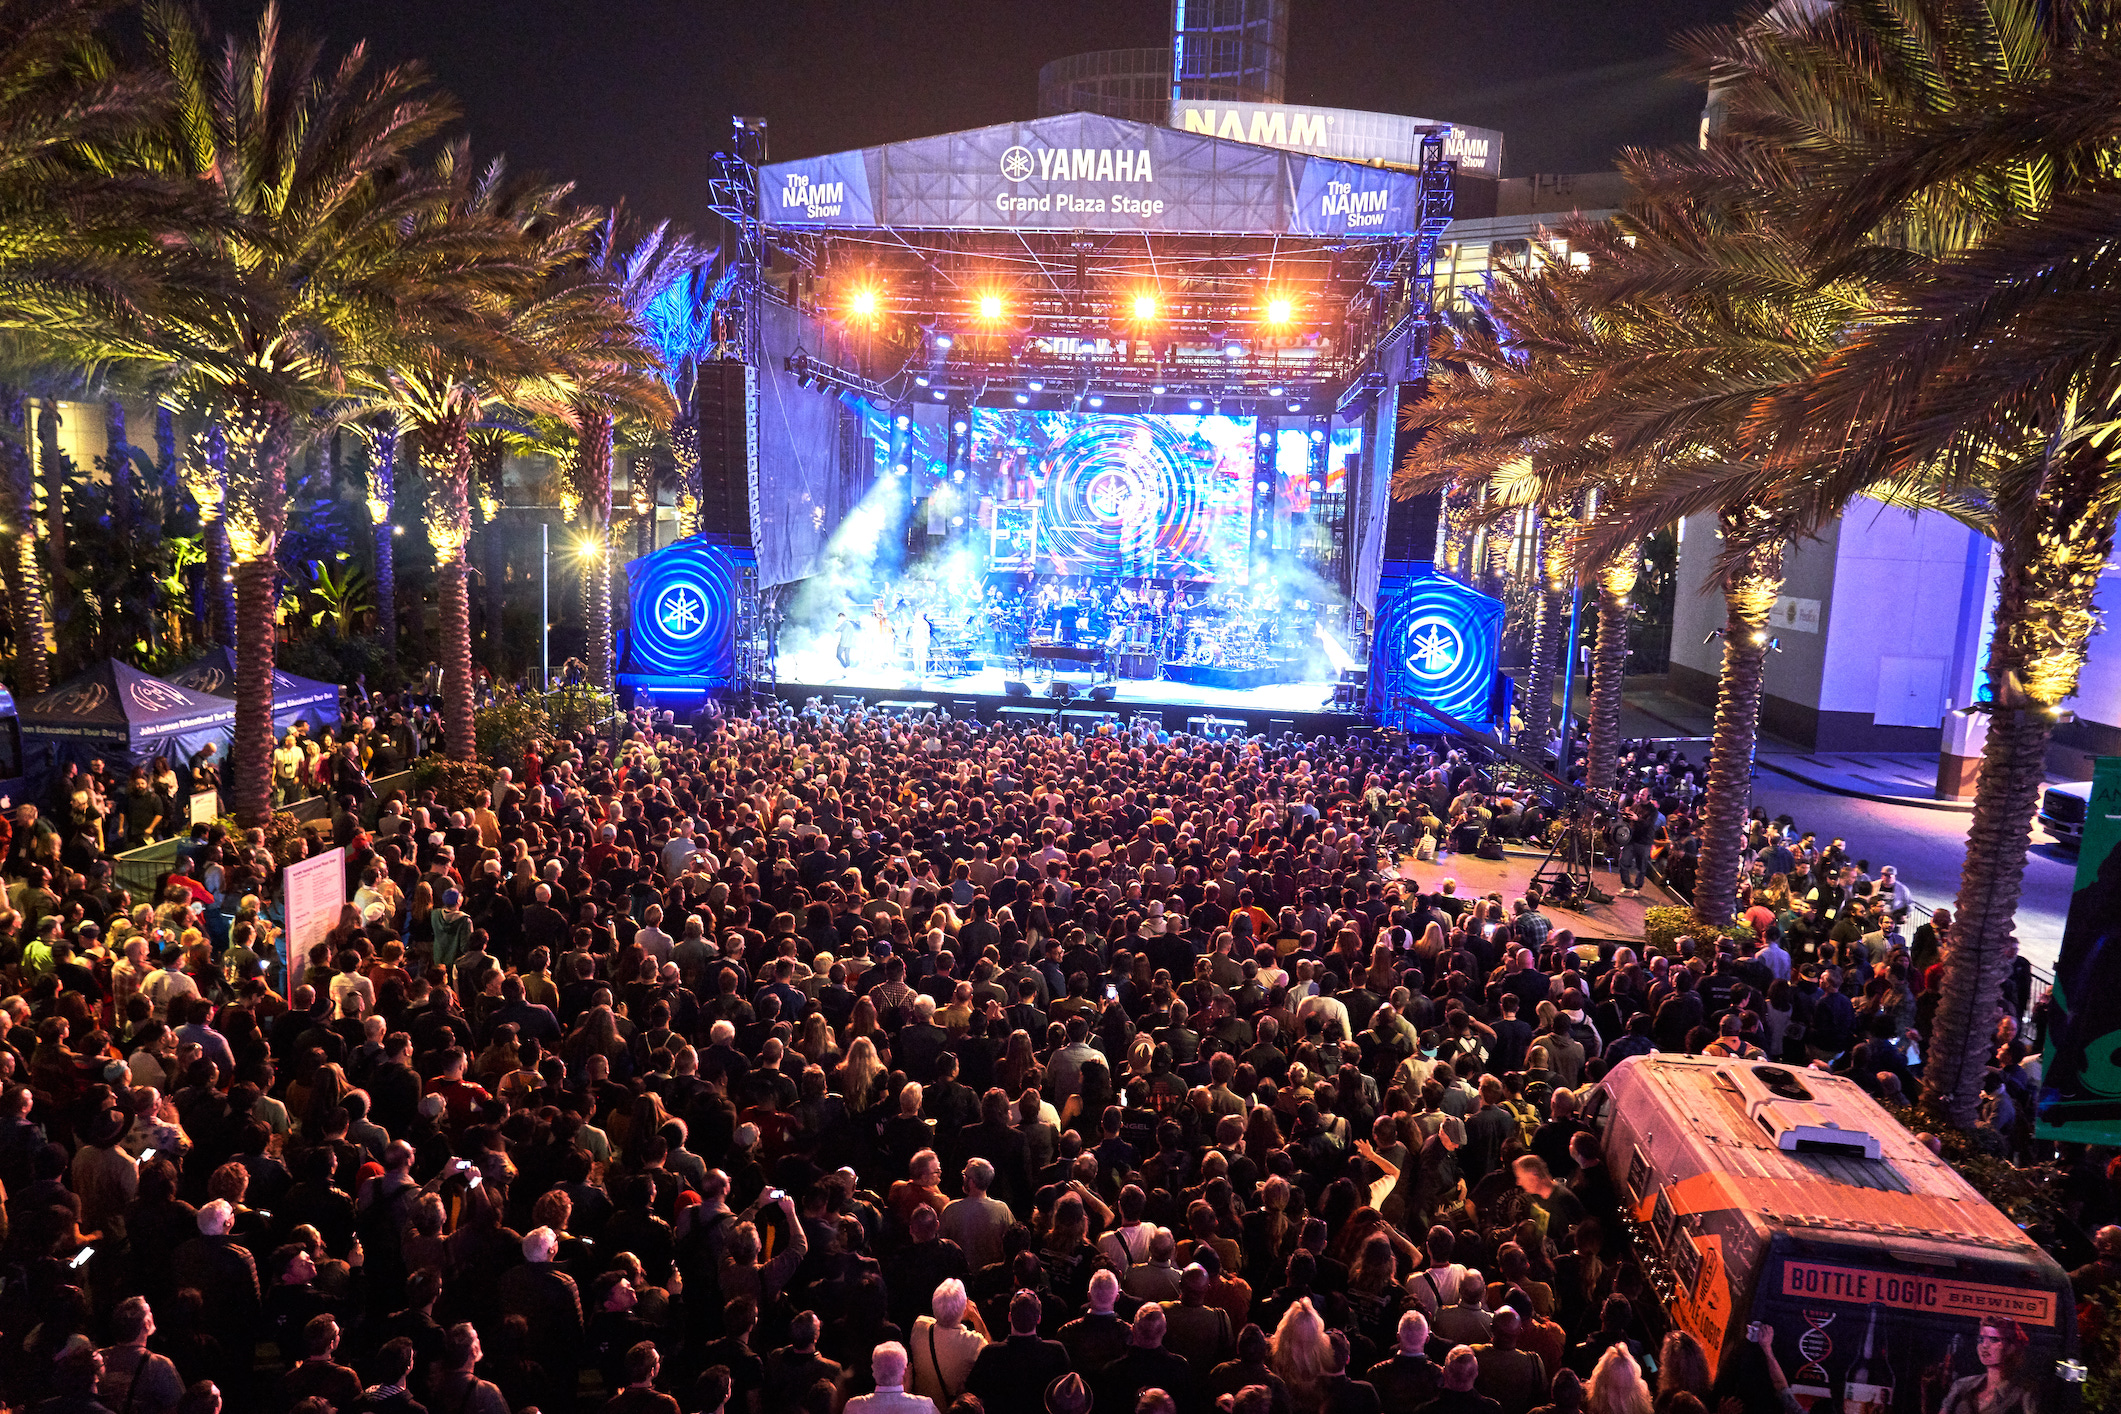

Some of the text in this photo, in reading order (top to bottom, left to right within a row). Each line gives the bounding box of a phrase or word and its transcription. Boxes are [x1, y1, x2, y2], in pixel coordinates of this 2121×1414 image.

[1449, 127, 1466, 140] The
[1445, 138, 1488, 157] NAMM
[1039, 148, 1153, 182] YAMAHA
[1461, 155, 1485, 168] Show
[787, 173, 809, 187] The
[1327, 181, 1351, 195] The
[782, 183, 843, 207] NAMM
[1321, 190, 1387, 216] NAMM
[807, 203, 842, 219] Show
[996, 193, 1164, 218] Grand Plaza Stage
[1347, 213, 1384, 228] Show
[287, 696, 313, 708] Educational
[35, 725, 82, 736] Educational
[83, 728, 101, 737] Tour
[101, 729, 117, 738] Bus
[139, 727, 156, 736] John
[156, 721, 180, 734] Lennon
[179, 713, 213, 729] Educational
[213, 712, 226, 722] Tour
[1792, 1267, 1938, 1306] BOTTLE LOGIC
[1948, 1293, 2037, 1312] BREWING
